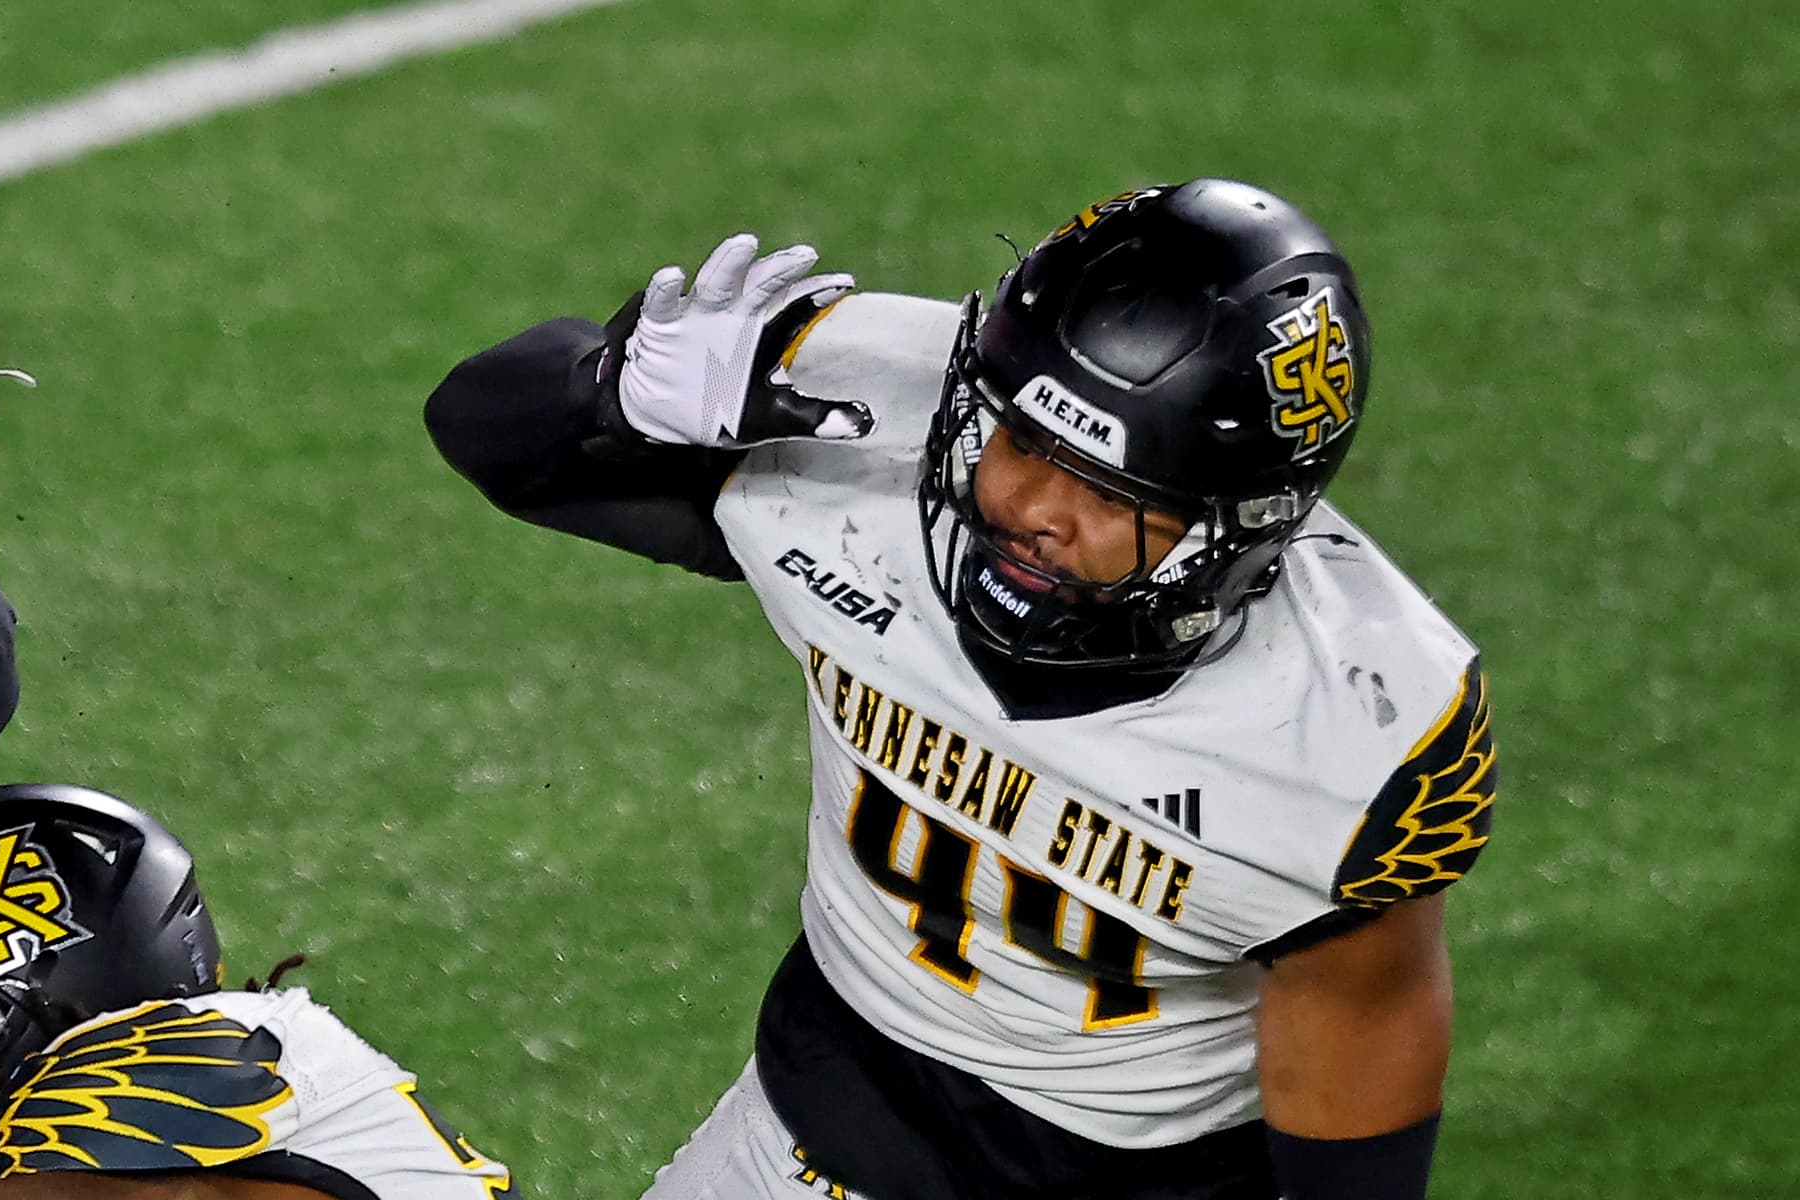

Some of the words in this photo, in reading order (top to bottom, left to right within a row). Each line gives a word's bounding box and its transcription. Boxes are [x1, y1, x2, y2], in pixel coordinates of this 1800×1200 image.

[1033, 384, 1112, 447] H.E.T.M.
[978, 567, 1031, 618] Riddell
[846, 766, 1160, 1033] 44
[1048, 797, 1194, 924] STATE
